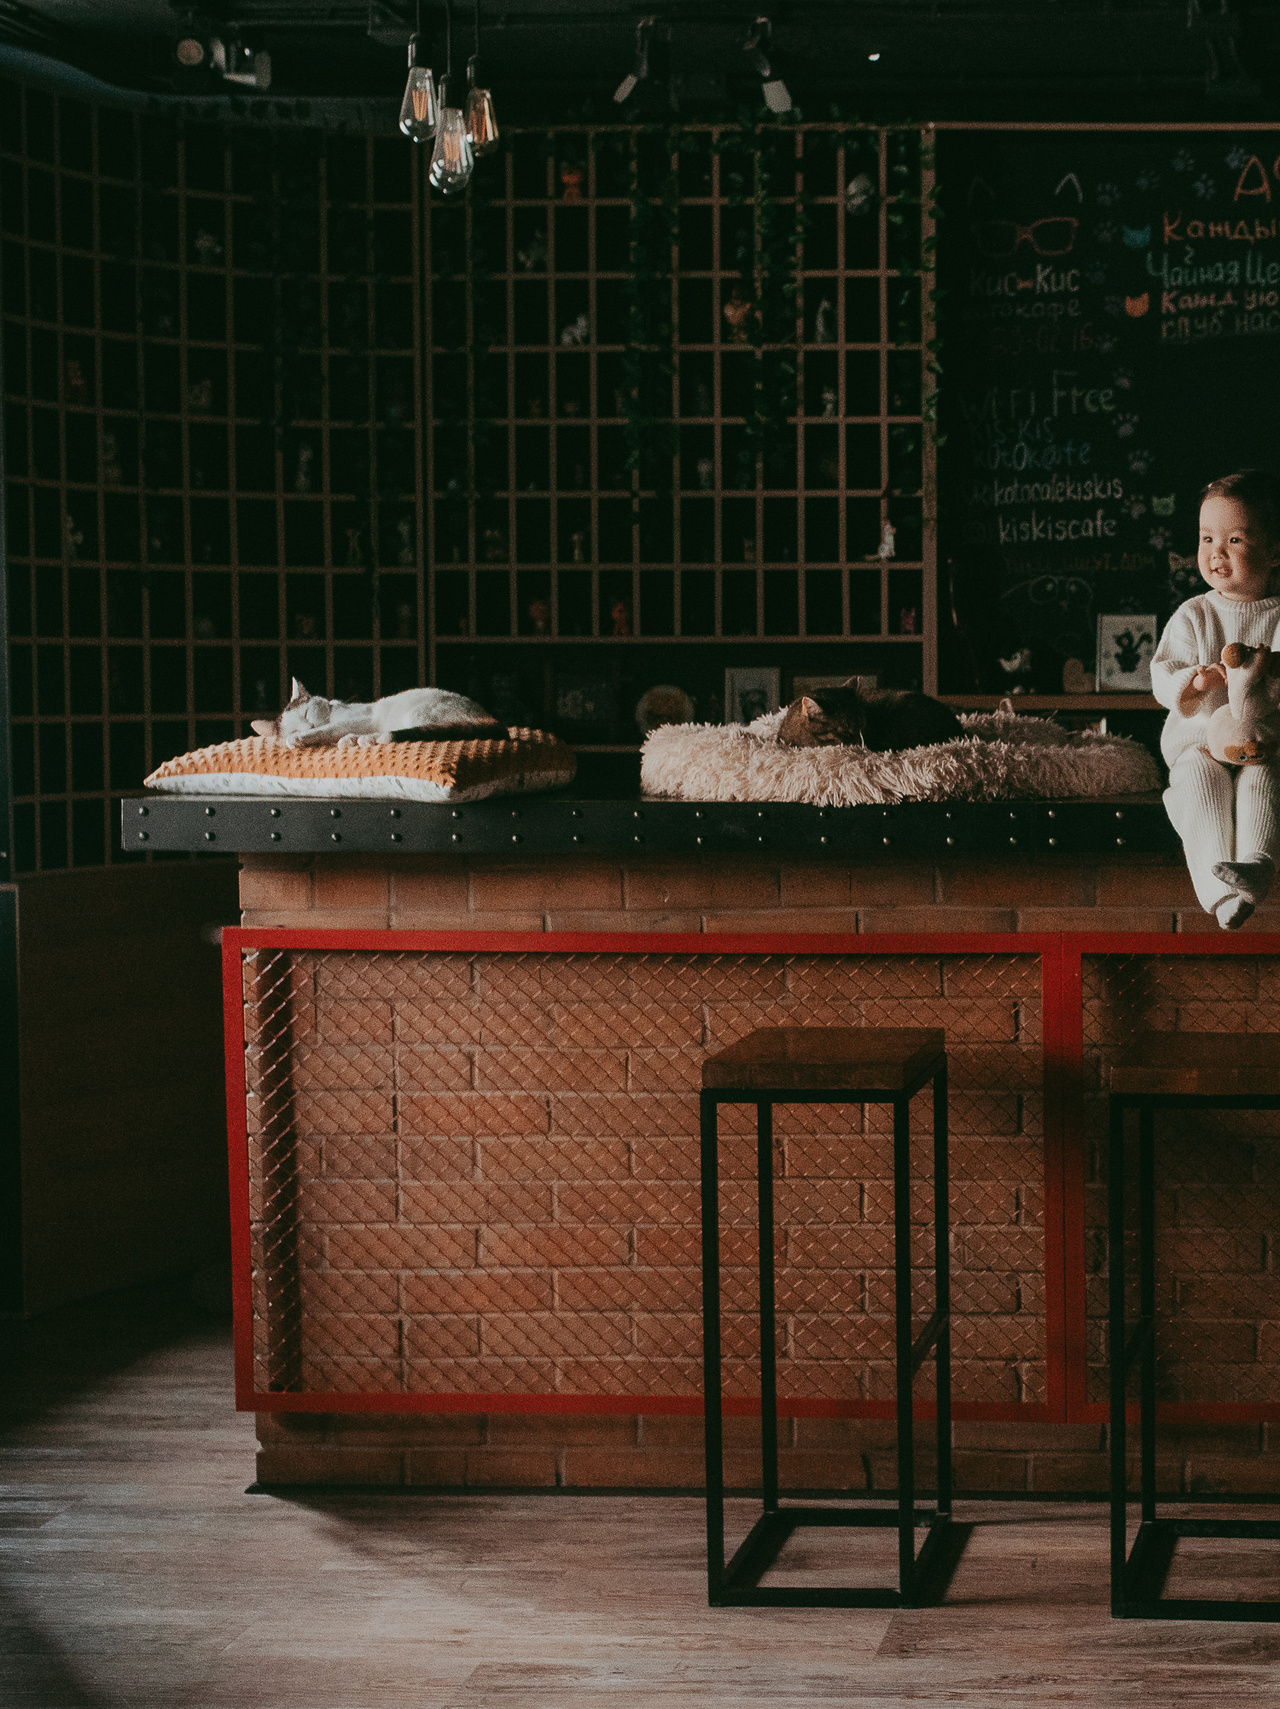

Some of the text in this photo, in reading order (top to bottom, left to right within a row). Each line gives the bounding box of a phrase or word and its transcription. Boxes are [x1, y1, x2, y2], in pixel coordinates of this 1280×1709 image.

[1146, 245, 1240, 289] Чайная
[1052, 369, 1117, 417] Free
[998, 509, 1118, 545] kiskiscafe
